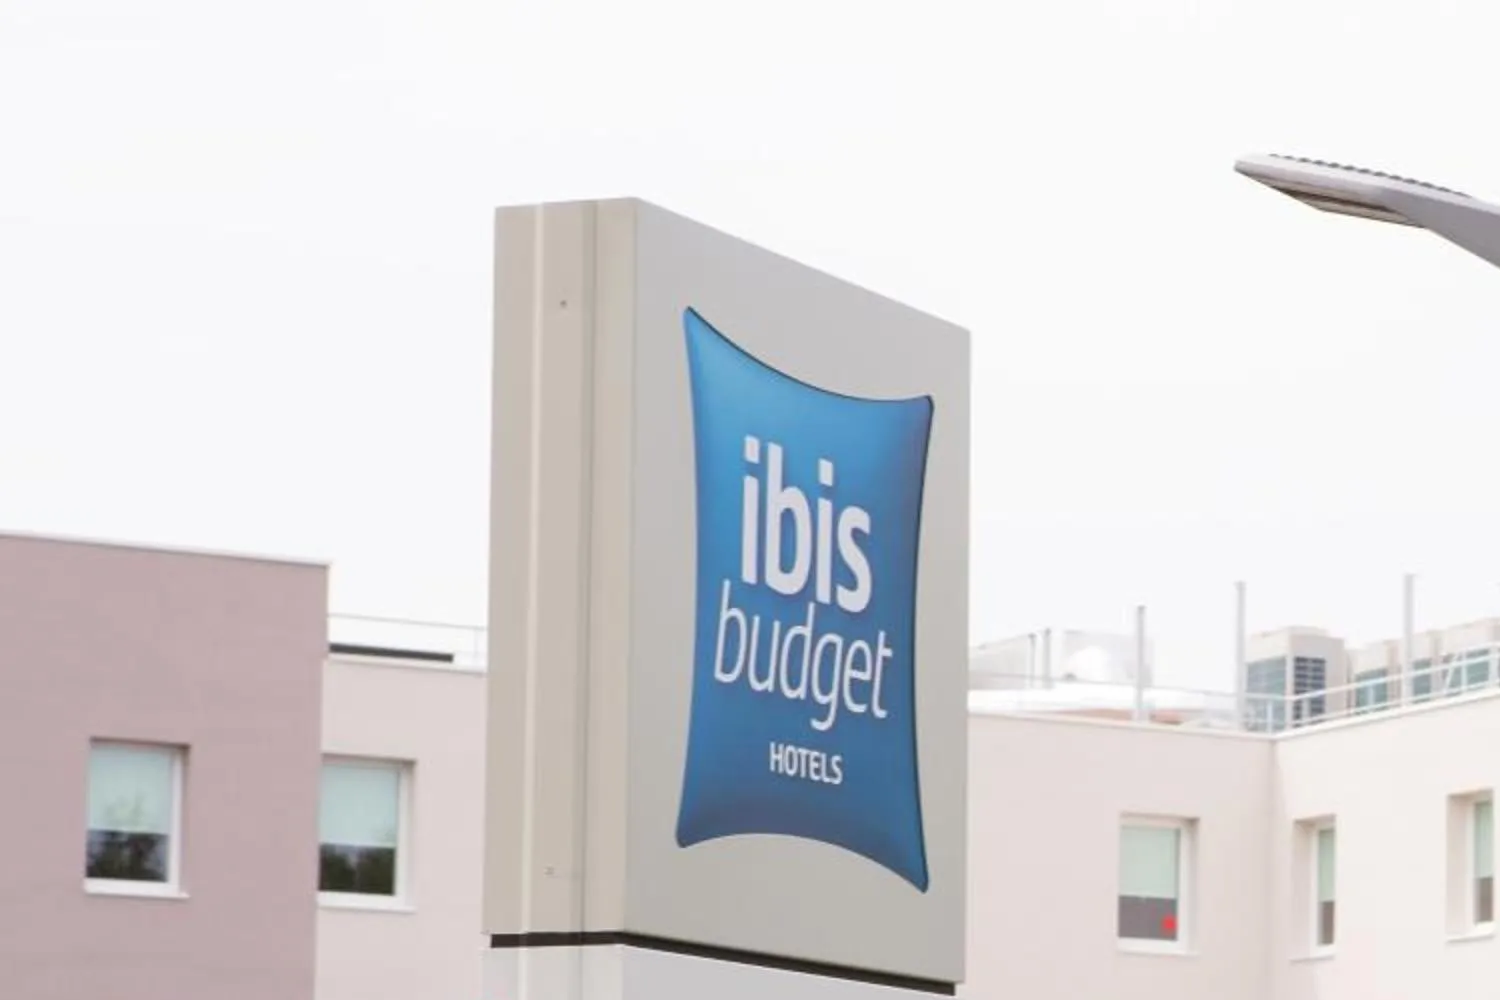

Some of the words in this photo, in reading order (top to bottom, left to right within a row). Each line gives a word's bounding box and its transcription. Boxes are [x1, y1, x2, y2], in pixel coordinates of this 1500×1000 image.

[740, 435, 873, 613] ibis
[713, 578, 893, 730] budget
[769, 742, 843, 785] HOTELS
